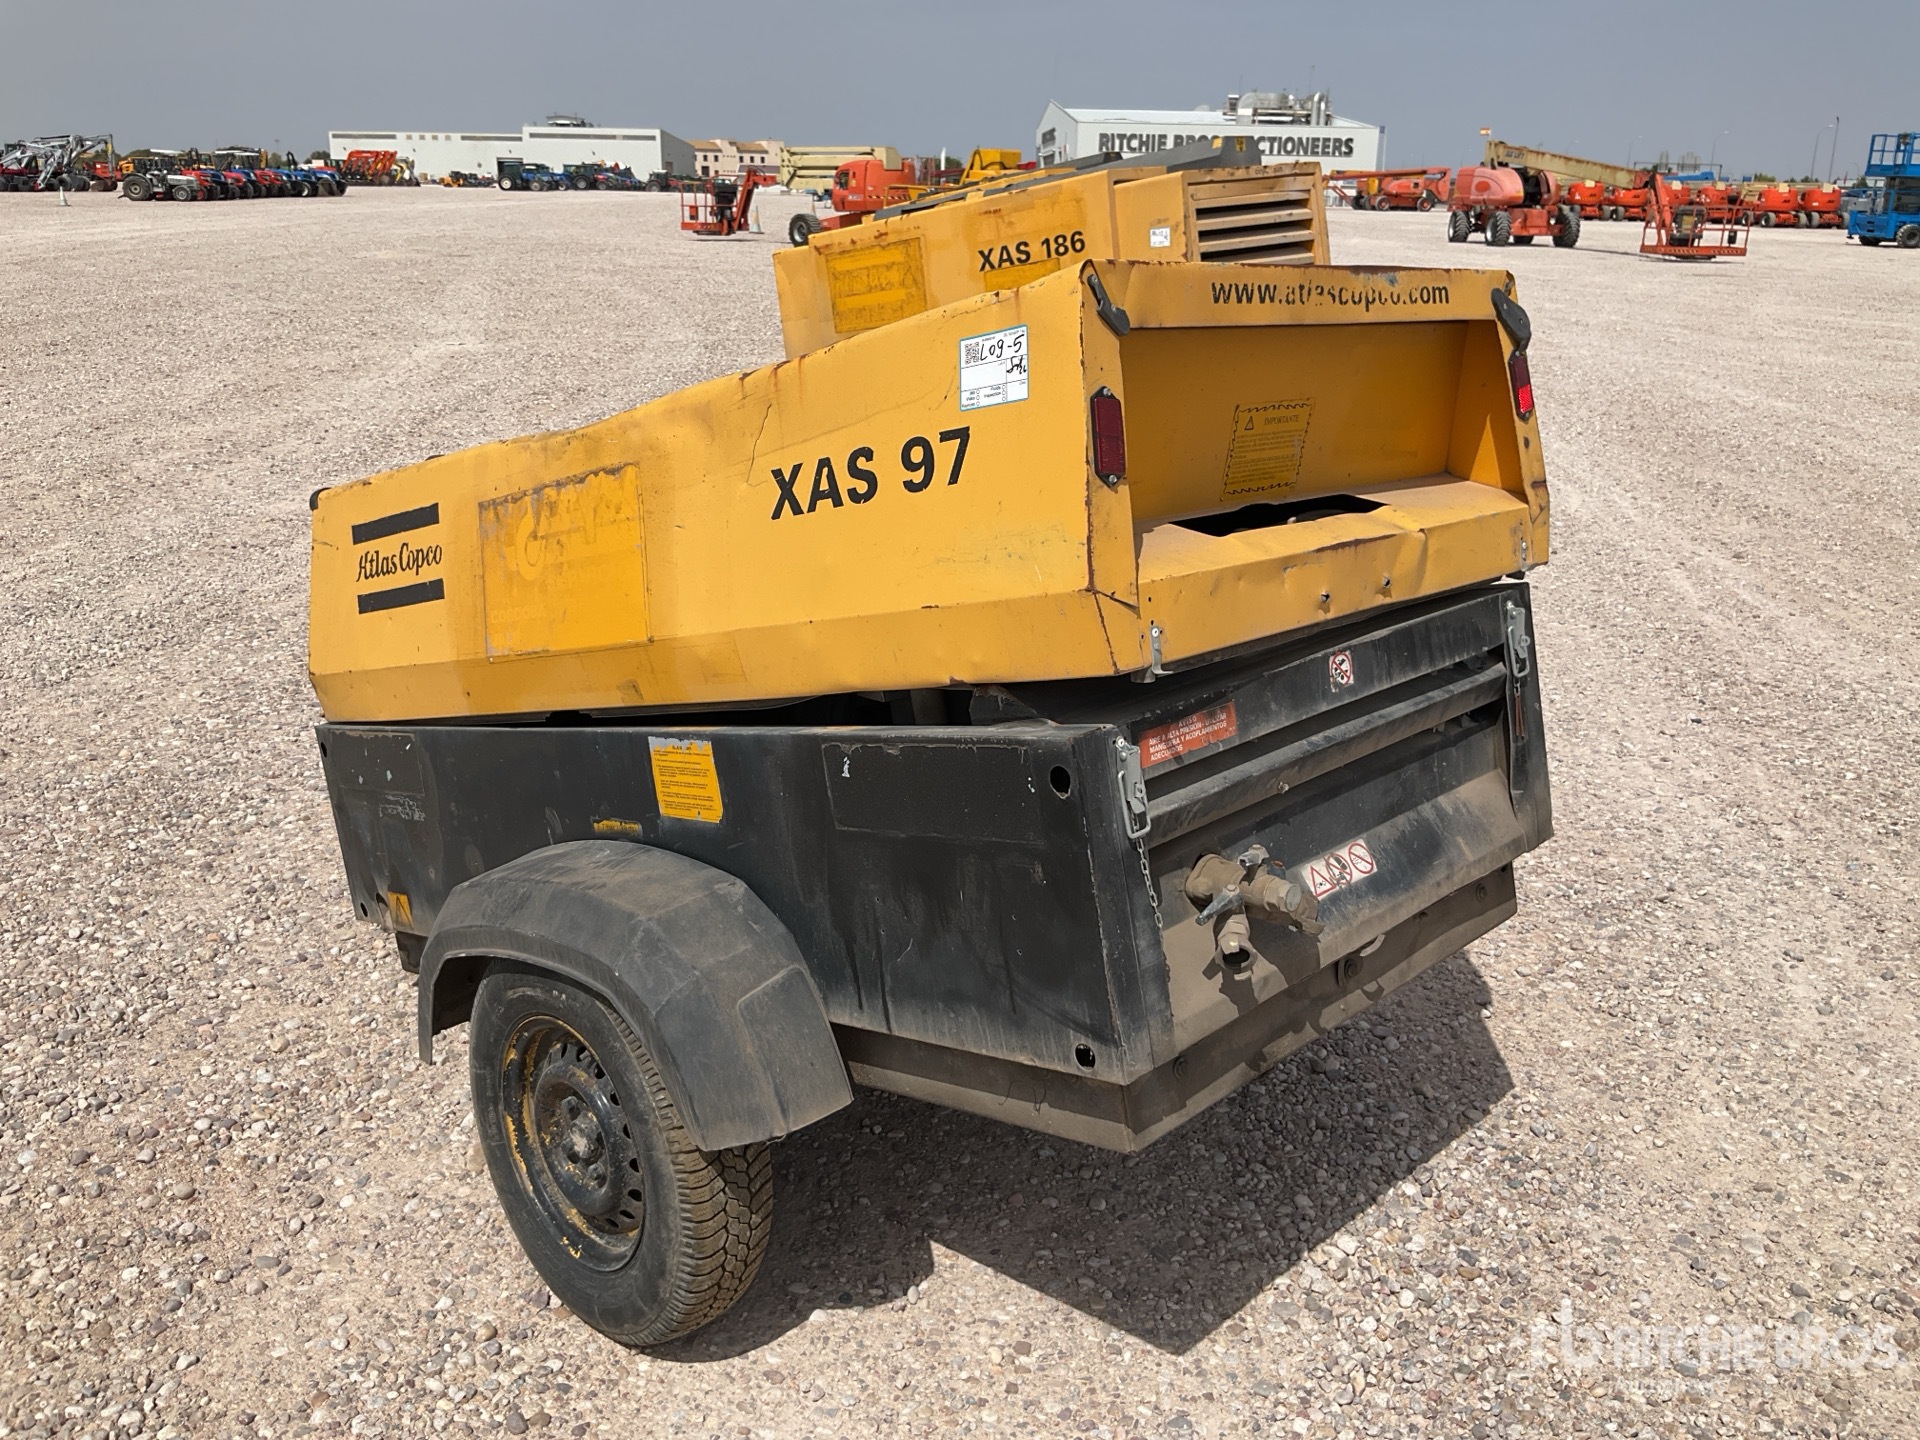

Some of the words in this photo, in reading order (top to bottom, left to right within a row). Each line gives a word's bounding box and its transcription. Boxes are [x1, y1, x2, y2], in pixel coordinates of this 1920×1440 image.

[1098, 132, 1168, 153] RITCHIE
[1255, 135, 1354, 156] CTIONEERS
[978, 241, 1031, 272] XAS
[1041, 230, 1085, 258] 186
[770, 446, 879, 521] XAS
[901, 425, 971, 493] 97
[355, 549, 398, 582] Atlas
[399, 542, 443, 576] Copco
[1178, 715, 1197, 728] AVISO
[1149, 735, 1161, 746] AIRE
[1167, 729, 1180, 740] ALTA
[1180, 734, 1185, 742] Y
